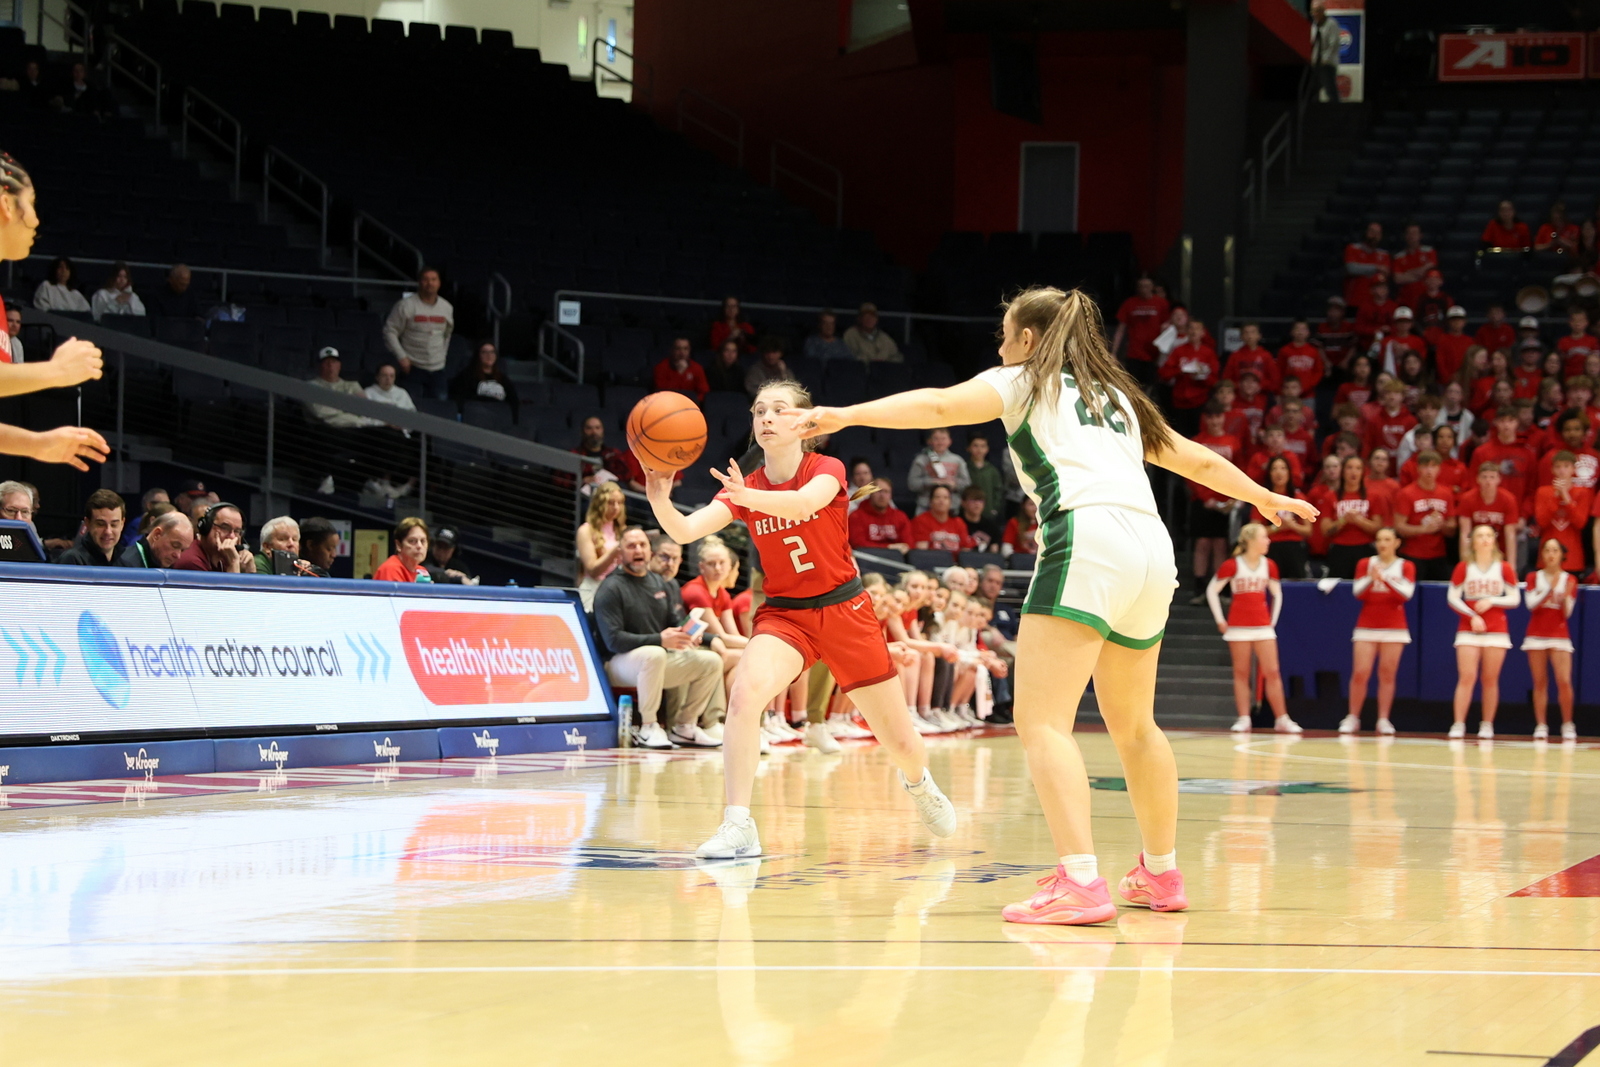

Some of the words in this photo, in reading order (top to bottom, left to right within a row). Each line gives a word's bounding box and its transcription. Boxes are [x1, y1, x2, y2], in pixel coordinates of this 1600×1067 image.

[782, 535, 815, 574] 2
[125, 636, 204, 678] health
[205, 638, 272, 678] action
[272, 639, 343, 678] council
[415, 637, 580, 684] healthykidsgo.org
[50, 734, 81, 742] DAKTRONICS
